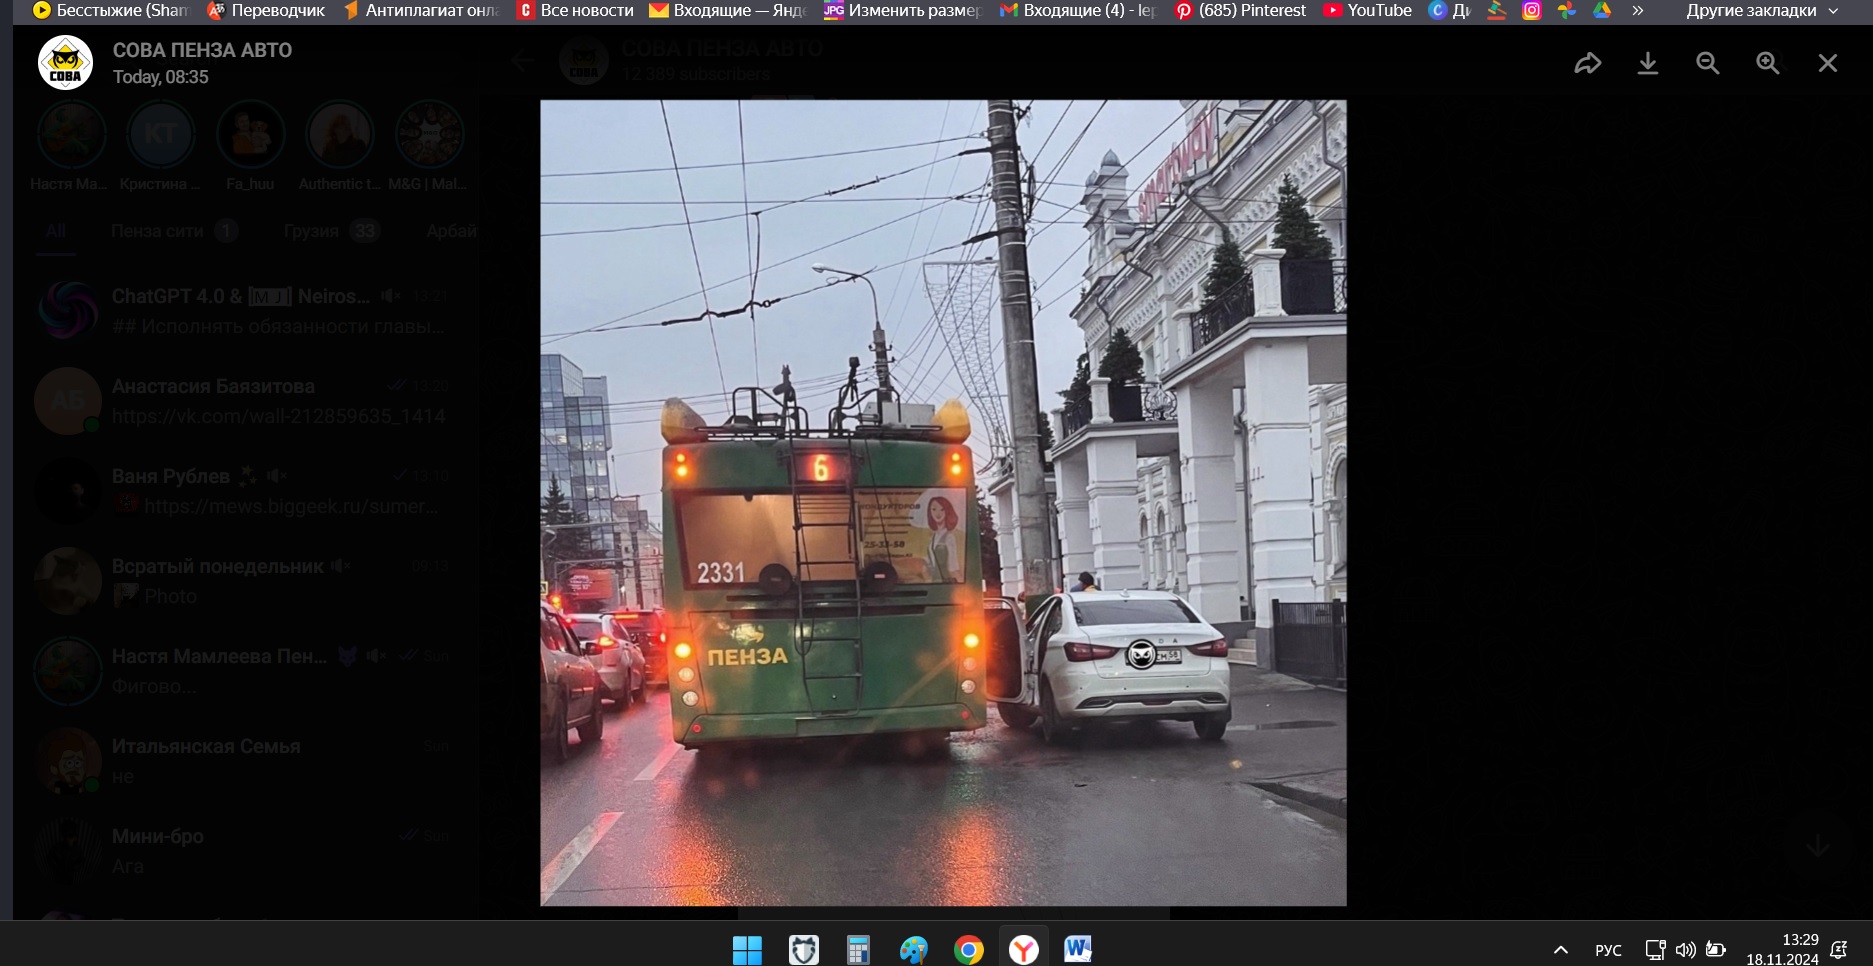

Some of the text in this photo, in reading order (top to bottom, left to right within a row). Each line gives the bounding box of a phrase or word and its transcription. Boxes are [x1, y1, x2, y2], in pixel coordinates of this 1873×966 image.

[58, 4, 142, 16] Бесстыжие
[233, 4, 325, 19] Переводчик
[366, 4, 464, 16] Антиплагиат
[542, 4, 633, 16] Все новости
[675, 4, 751, 18] Входящие
[824, 6, 844, 15] JPG
[850, 4, 925, 16] Изменить
[1025, 4, 1101, 18] Входящие
[1106, 3, 1124, 18] (4)
[1200, 3, 1306, 18] (685) Pinterest
[1348, 4, 1412, 16] YouTube
[1687, 4, 1816, 19] Другие закладки
[113, 42, 292, 58] СОВА ПЕНЗА АВТО
[622, 40, 823, 57] СОВА ПЕНЗА АВТО
[50, 70, 81, 82] СОВА
[113, 69, 208, 87] Today, 08:35
[623, 66, 770, 80] 12 389 subscribers
[144, 122, 178, 144] КТ
[31, 178, 107, 190] Настя Ма...
[120, 178, 186, 192] Кристина
[227, 177, 274, 191] Fa_huu
[299, 178, 363, 190] Authentic
[389, 178, 421, 190] M&G
[433, 178, 467, 190] Mal...
[46, 223, 65, 238] All
[112, 224, 203, 238] Пенза сити
[285, 224, 338, 241] Грузия
[355, 223, 375, 239] 33
[112, 288, 192, 304] ChatGPT
[196, 288, 224, 303] 4.0
[230, 288, 242, 304] &
[299, 288, 370, 304] Neiros...
[414, 290, 446, 302] 13:21
[113, 317, 444, 335] ## Исполнять обязанности главы...
[112, 378, 315, 394] Анастасия Баязитова
[413, 380, 448, 392] 13:20
[50, 391, 86, 411] АБ
[113, 408, 446, 427] https://vk.com/wall-212859635_1414
[814, 454, 827, 481] 6
[113, 467, 230, 488] Ваня Рублев
[413, 470, 448, 481] 13:10
[145, 498, 437, 518] https://mews.biggeek.ru/sumer...
[113, 558, 324, 577] Всратый понедельник
[412, 560, 448, 572] 09:13
[697, 562, 745, 584] 2331
[146, 588, 197, 604] Photo
[113, 648, 327, 664] Настя Мамлеева Пен...
[424, 650, 448, 662] Sun
[708, 648, 788, 666] ПЕНЗА
[112, 678, 196, 694] Фигово...
[113, 738, 300, 754] Итальянская Семья
[424, 740, 448, 752] Sun
[113, 772, 134, 783] не
[113, 827, 204, 847] Мини-бро
[424, 830, 448, 841] Sun
[112, 858, 144, 873] Ага
[1784, 934, 1819, 945] 13:29
[1596, 945, 1621, 956] РУС
[1747, 954, 1819, 965] 18.11.2024
